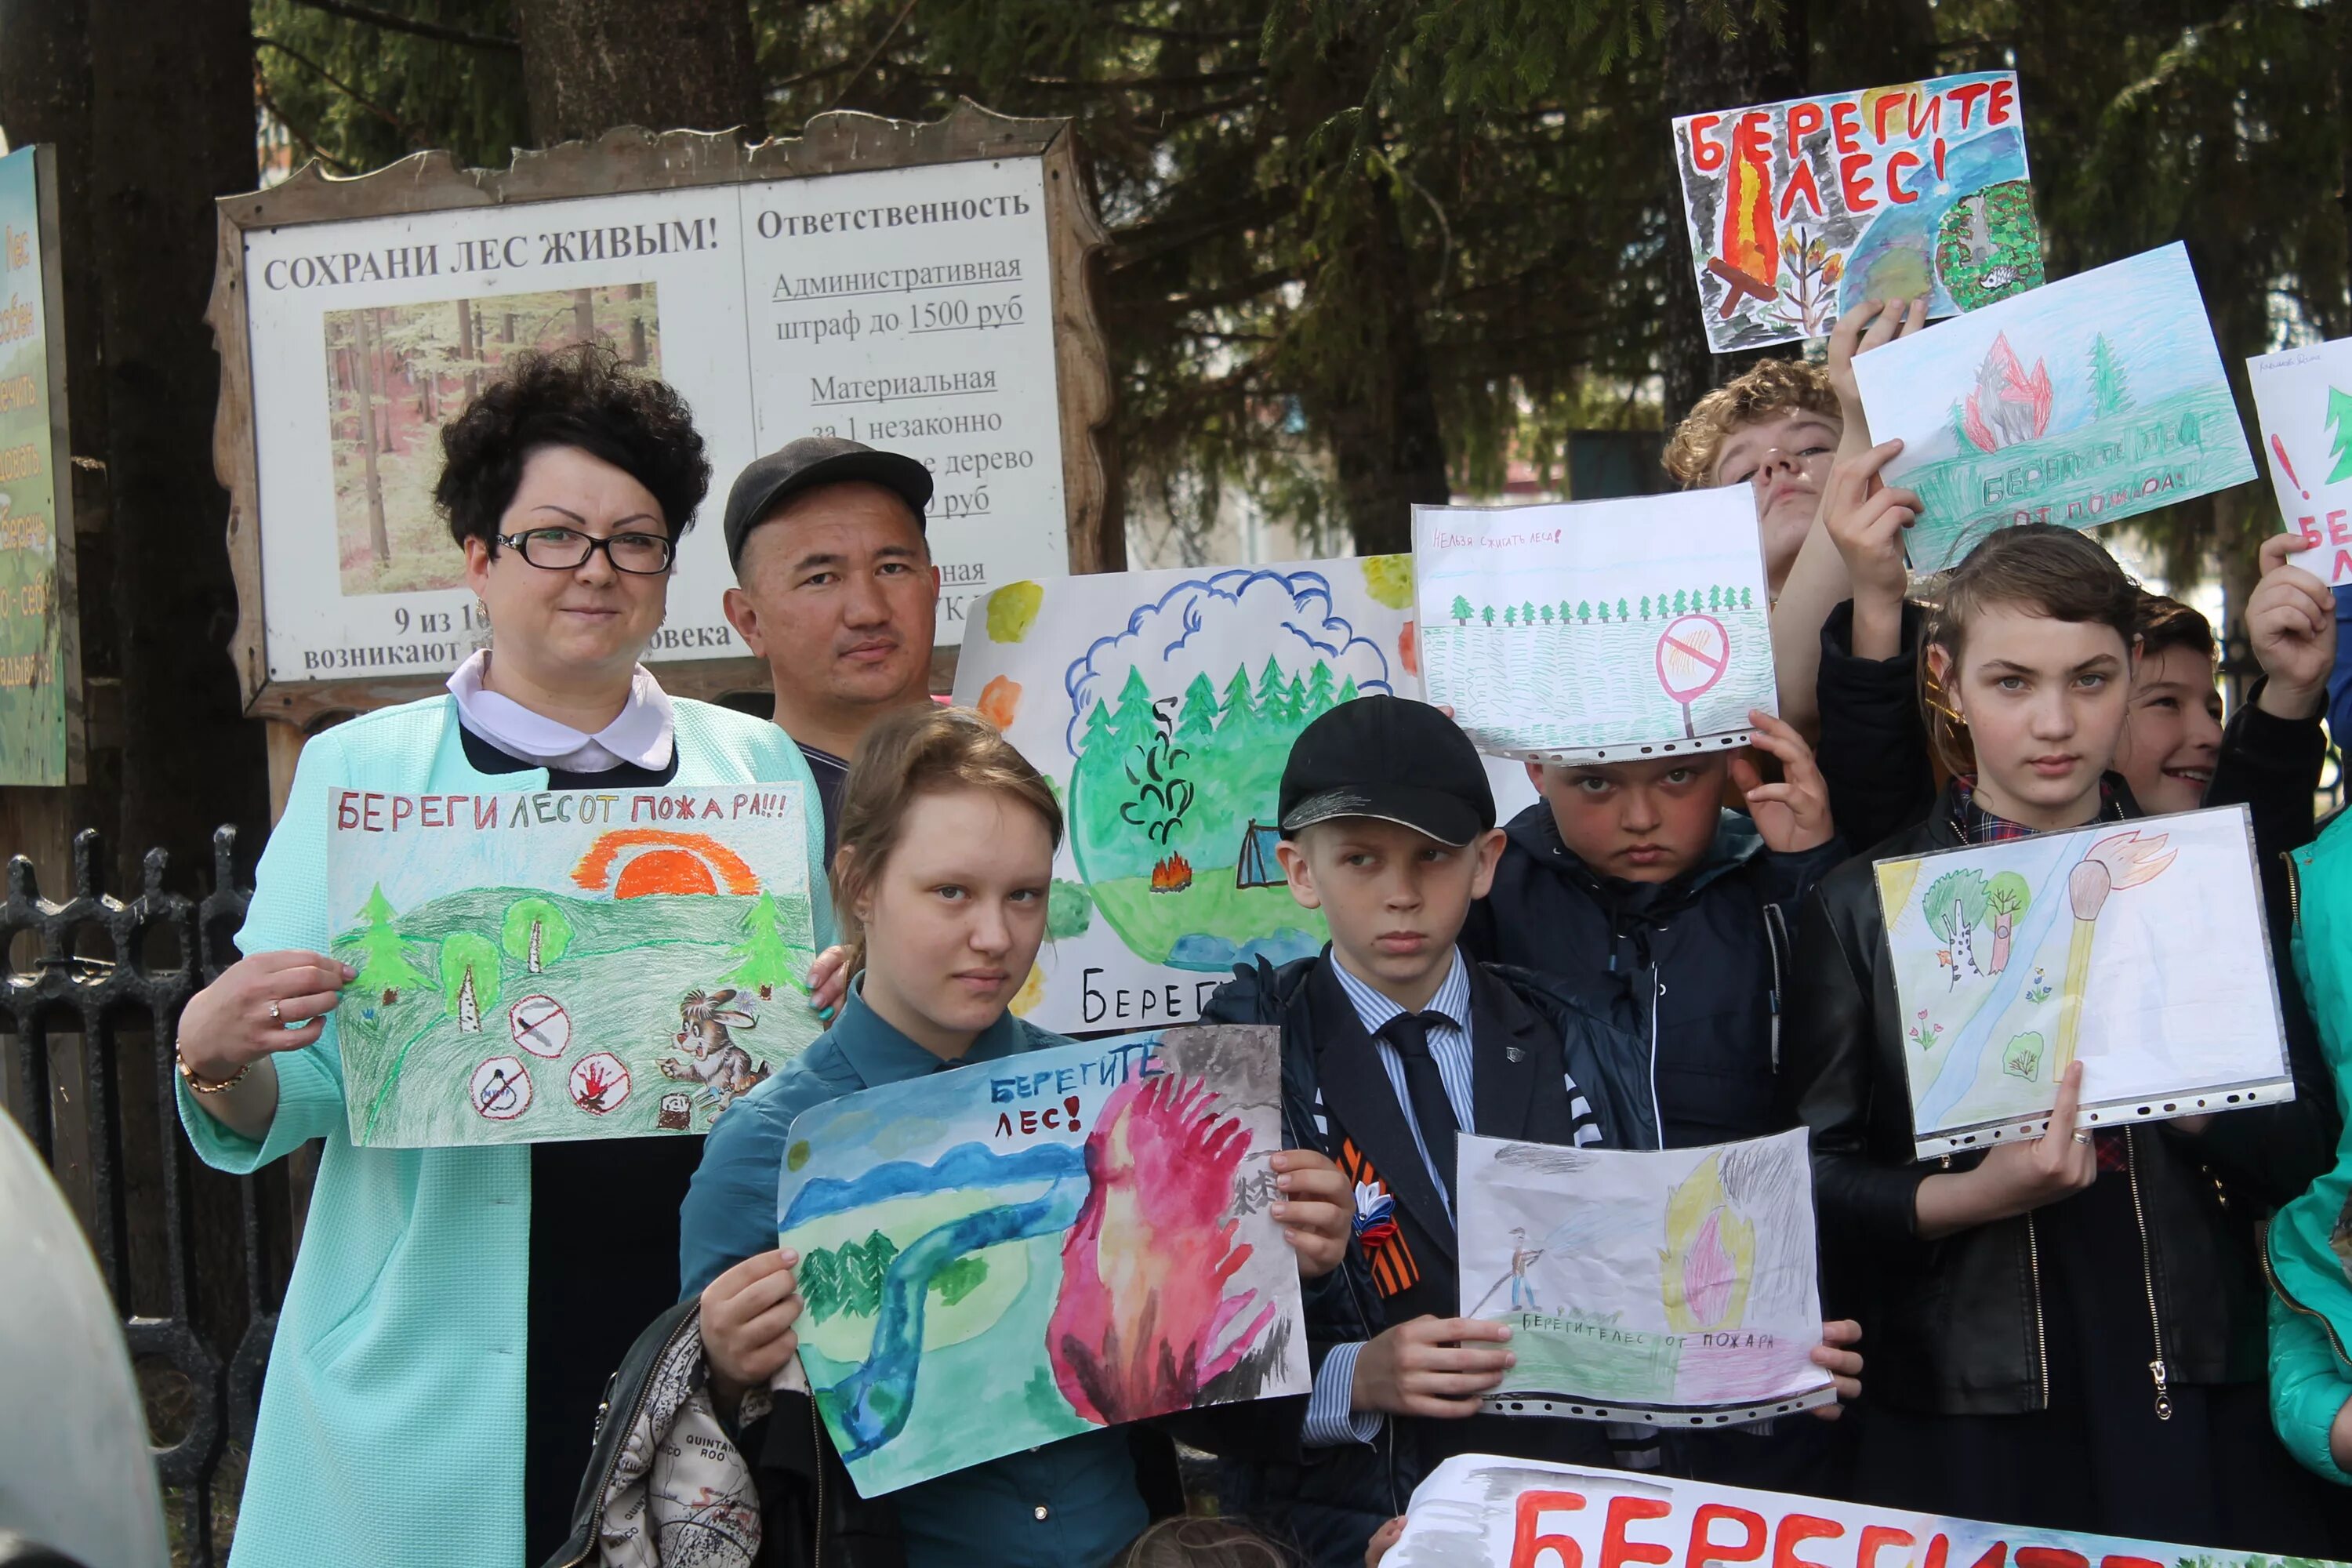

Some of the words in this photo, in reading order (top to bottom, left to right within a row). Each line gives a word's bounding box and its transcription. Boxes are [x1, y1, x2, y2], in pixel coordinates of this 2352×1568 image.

[1690, 81, 2013, 172] БЕРЕГИТЕ
[1780, 137, 1949, 220] ЛЕС!
[757, 194, 1030, 239] Ответственность
[263, 244, 439, 291] СОХРАНИ
[450, 235, 528, 273] ЛЕС
[540, 217, 720, 266] ЖИВЫМ!
[772, 258, 1022, 300] Административная
[777, 309, 861, 344] штраф
[869, 319, 899, 336] до
[909, 299, 969, 332] 1500
[978, 295, 1023, 330] руб
[811, 368, 996, 404] Материальная
[849, 418, 858, 441] 1
[869, 411, 1002, 441] незаконно
[946, 448, 1034, 478] дерево
[944, 485, 991, 520] руб
[1433, 528, 1474, 549] НЕЛЬЗЯ
[1480, 535, 1525, 550] СЖИГАТЬ
[1530, 528, 1562, 544] ЛЕСА!
[394, 608, 411, 636] 9
[420, 612, 452, 633] из
[304, 640, 459, 670] возникают
[649, 625, 731, 650] овека
[338, 792, 498, 832] БЕРЕГИ
[1083, 967, 1223, 1024] БЕРЕГ
[989, 1042, 1167, 1104] БЕРЕГИТЕ
[994, 1095, 1081, 1138] ЛЕС!
[1665, 1336, 1687, 1348] ОТ
[1703, 1333, 1774, 1348] ПОЖАРА
[700, 1448, 725, 1462] ROO
